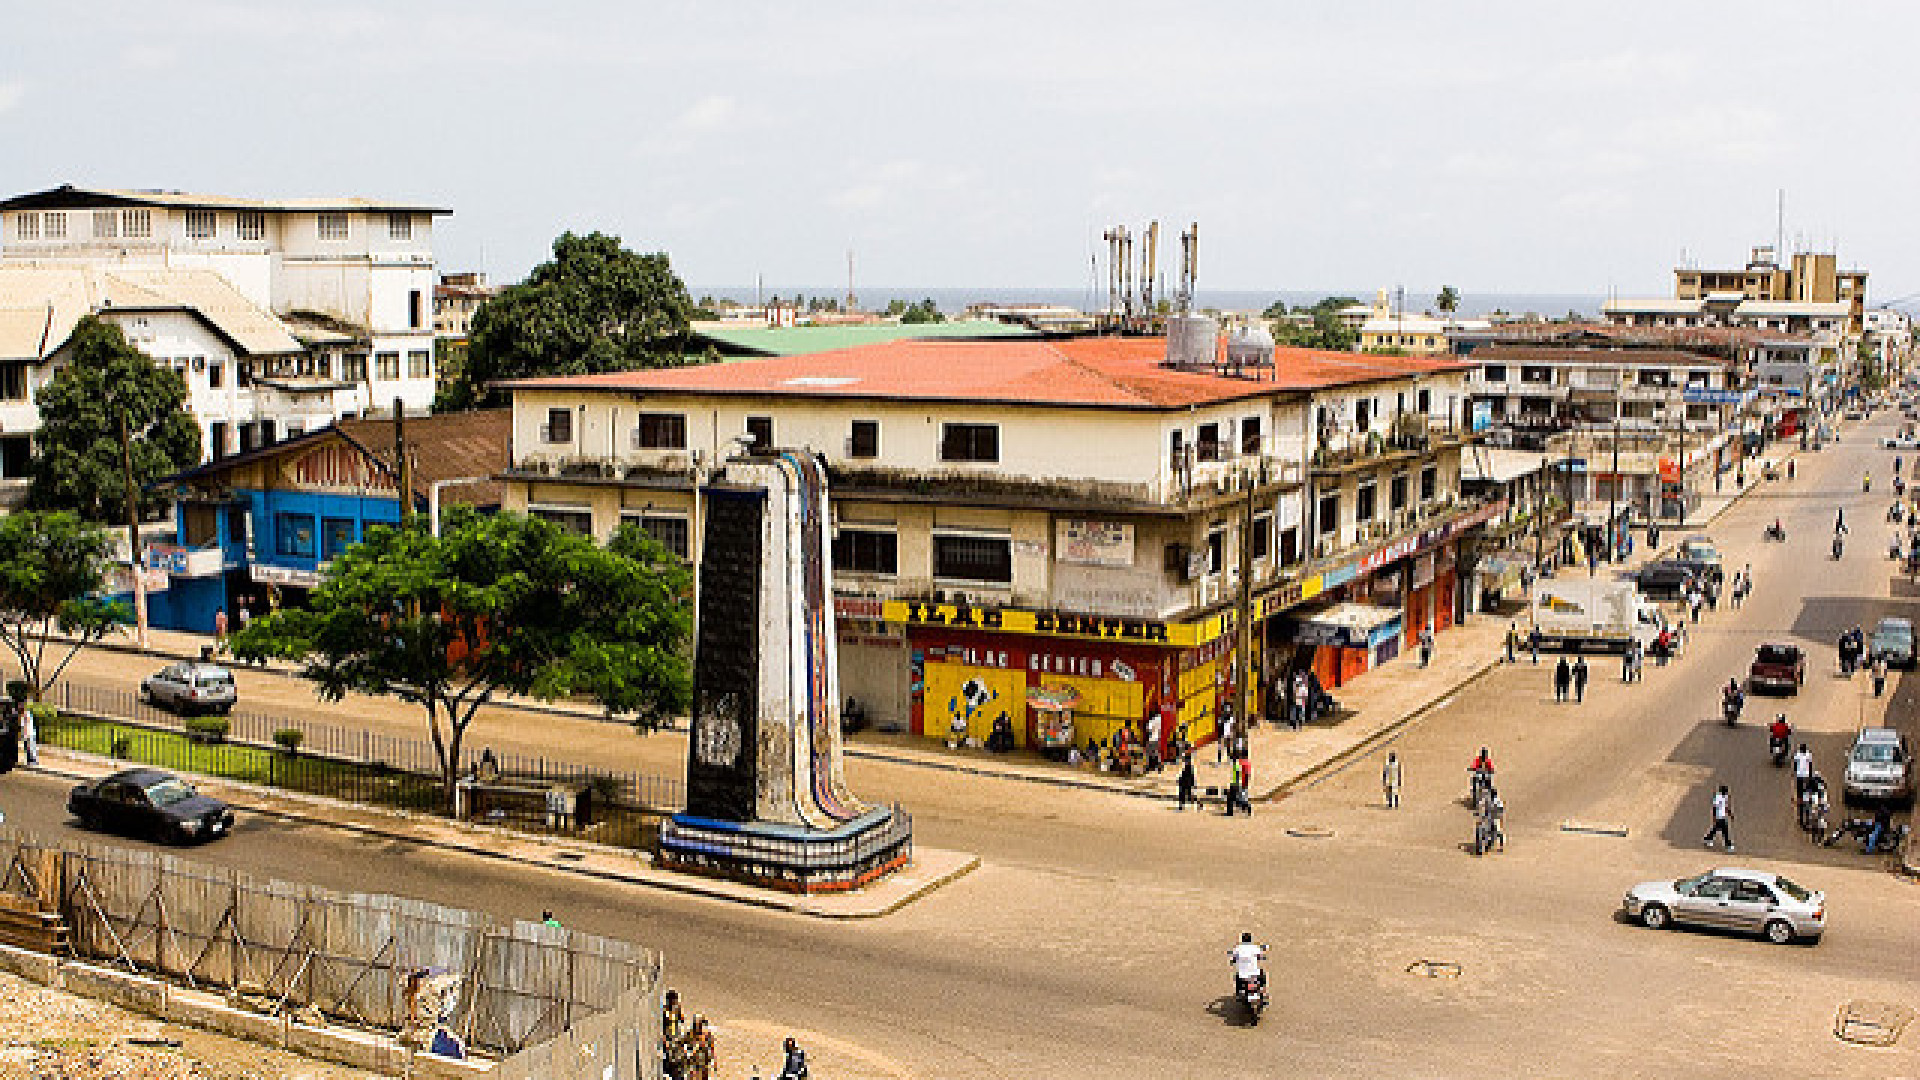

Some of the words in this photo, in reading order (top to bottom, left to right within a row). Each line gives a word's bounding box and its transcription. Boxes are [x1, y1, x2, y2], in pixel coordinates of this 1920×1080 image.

[908, 603, 1003, 627] ILAC
[1035, 612, 1168, 640] CENTER
[1029, 653, 1103, 677] CENTER
